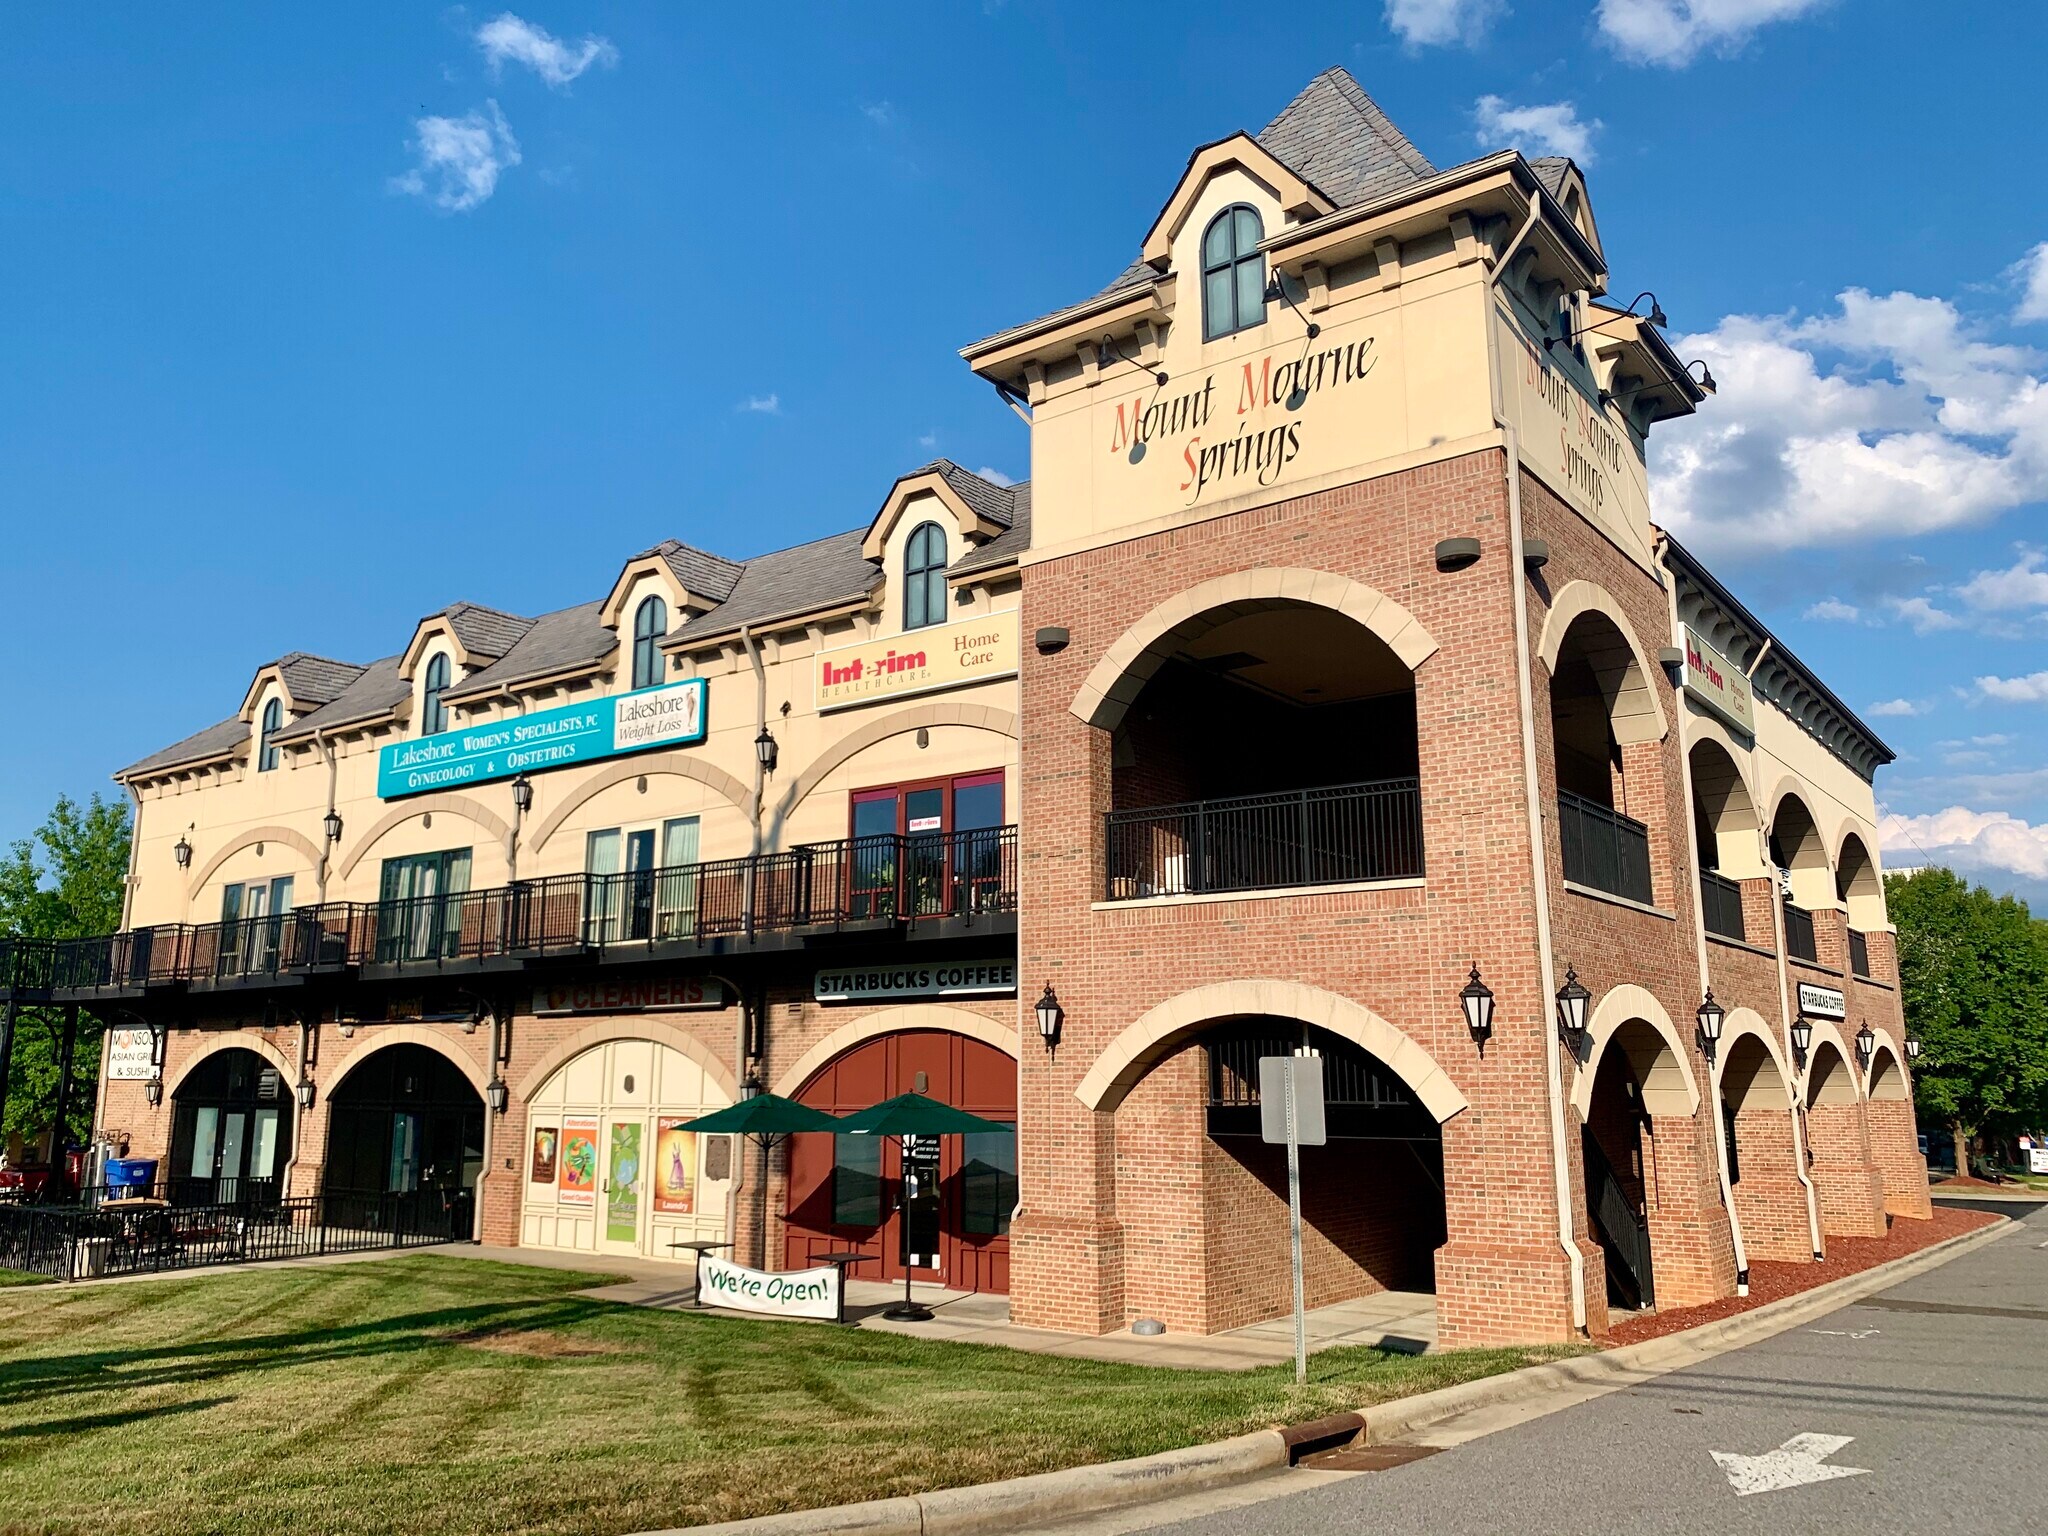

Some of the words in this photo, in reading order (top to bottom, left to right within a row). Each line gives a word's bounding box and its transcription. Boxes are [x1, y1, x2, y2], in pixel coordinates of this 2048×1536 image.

[1110, 373, 1216, 453] Mount
[1237, 337, 1378, 415] Mourne
[1527, 338, 1570, 422] Mount
[1577, 392, 1622, 474] Mourne
[1180, 421, 1302, 507] Springs
[1560, 427, 1605, 516] Springs
[822, 650, 926, 687] Interim
[954, 632, 1000, 652] Home
[822, 669, 927, 698] HEALTHCARE
[960, 652, 994, 667] Care
[619, 695, 684, 723] Lakeshore
[392, 741, 456, 769] Lakeshore
[463, 731, 510, 751] WOMEN'S
[585, 714, 599, 727] PC
[619, 722, 655, 741] Weight
[657, 720, 682, 734] Loss
[408, 763, 476, 788] GYNECOLOGY
[487, 762, 495, 774] &
[507, 743, 576, 769] OBSTETRICS
[573, 977, 704, 1009] CLEANERS
[819, 969, 930, 993] STARBUCKS
[935, 965, 1013, 987] COFFEE
[1802, 990, 1829, 1009] STARBUCKS
[1829, 995, 1844, 1011] COFFEE
[111, 1052, 135, 1061] ASIAN
[117, 1067, 124, 1077] &
[126, 1067, 150, 1077] SUSHI
[662, 1200, 688, 1212] Laundry
[708, 1266, 761, 1297] We're
[766, 1278, 828, 1305] Open!
